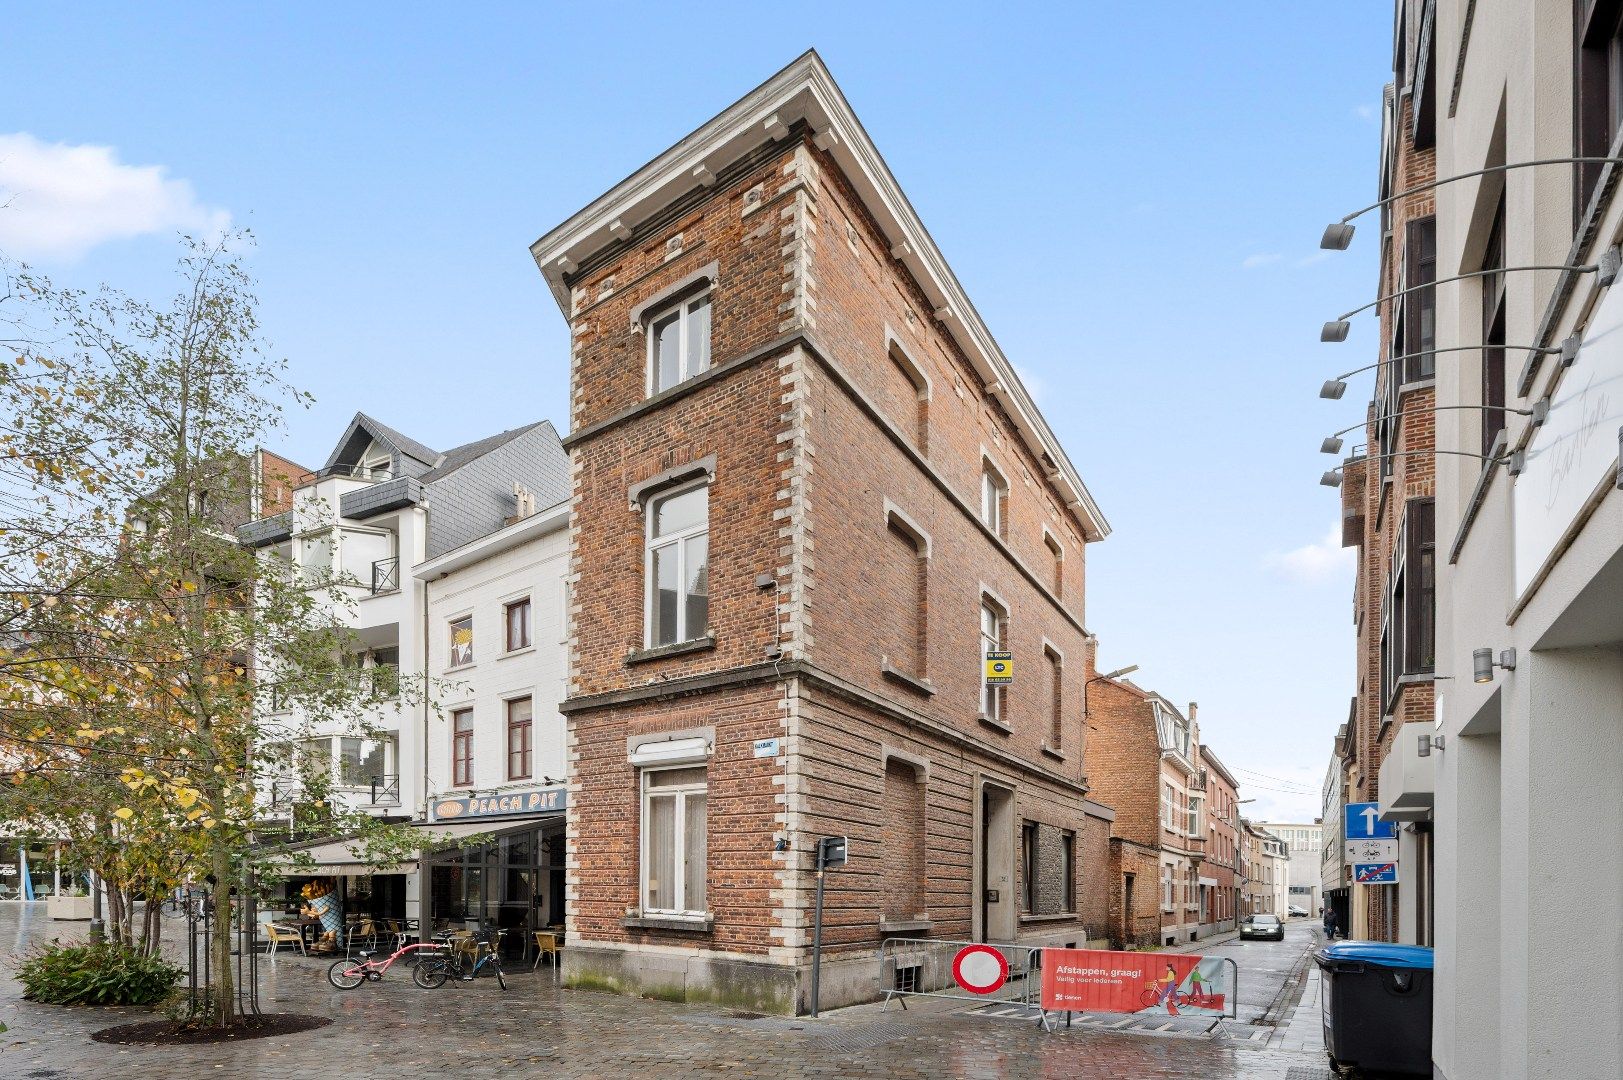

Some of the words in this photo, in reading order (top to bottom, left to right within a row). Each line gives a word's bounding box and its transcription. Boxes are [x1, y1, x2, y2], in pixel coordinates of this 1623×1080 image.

[469, 796, 522, 814] PEACH
[529, 792, 558, 809] PIT
[1056, 966, 1109, 976] Afstappen,
[1110, 969, 1141, 978] graag!
[1056, 976, 1075, 984] Veilig
